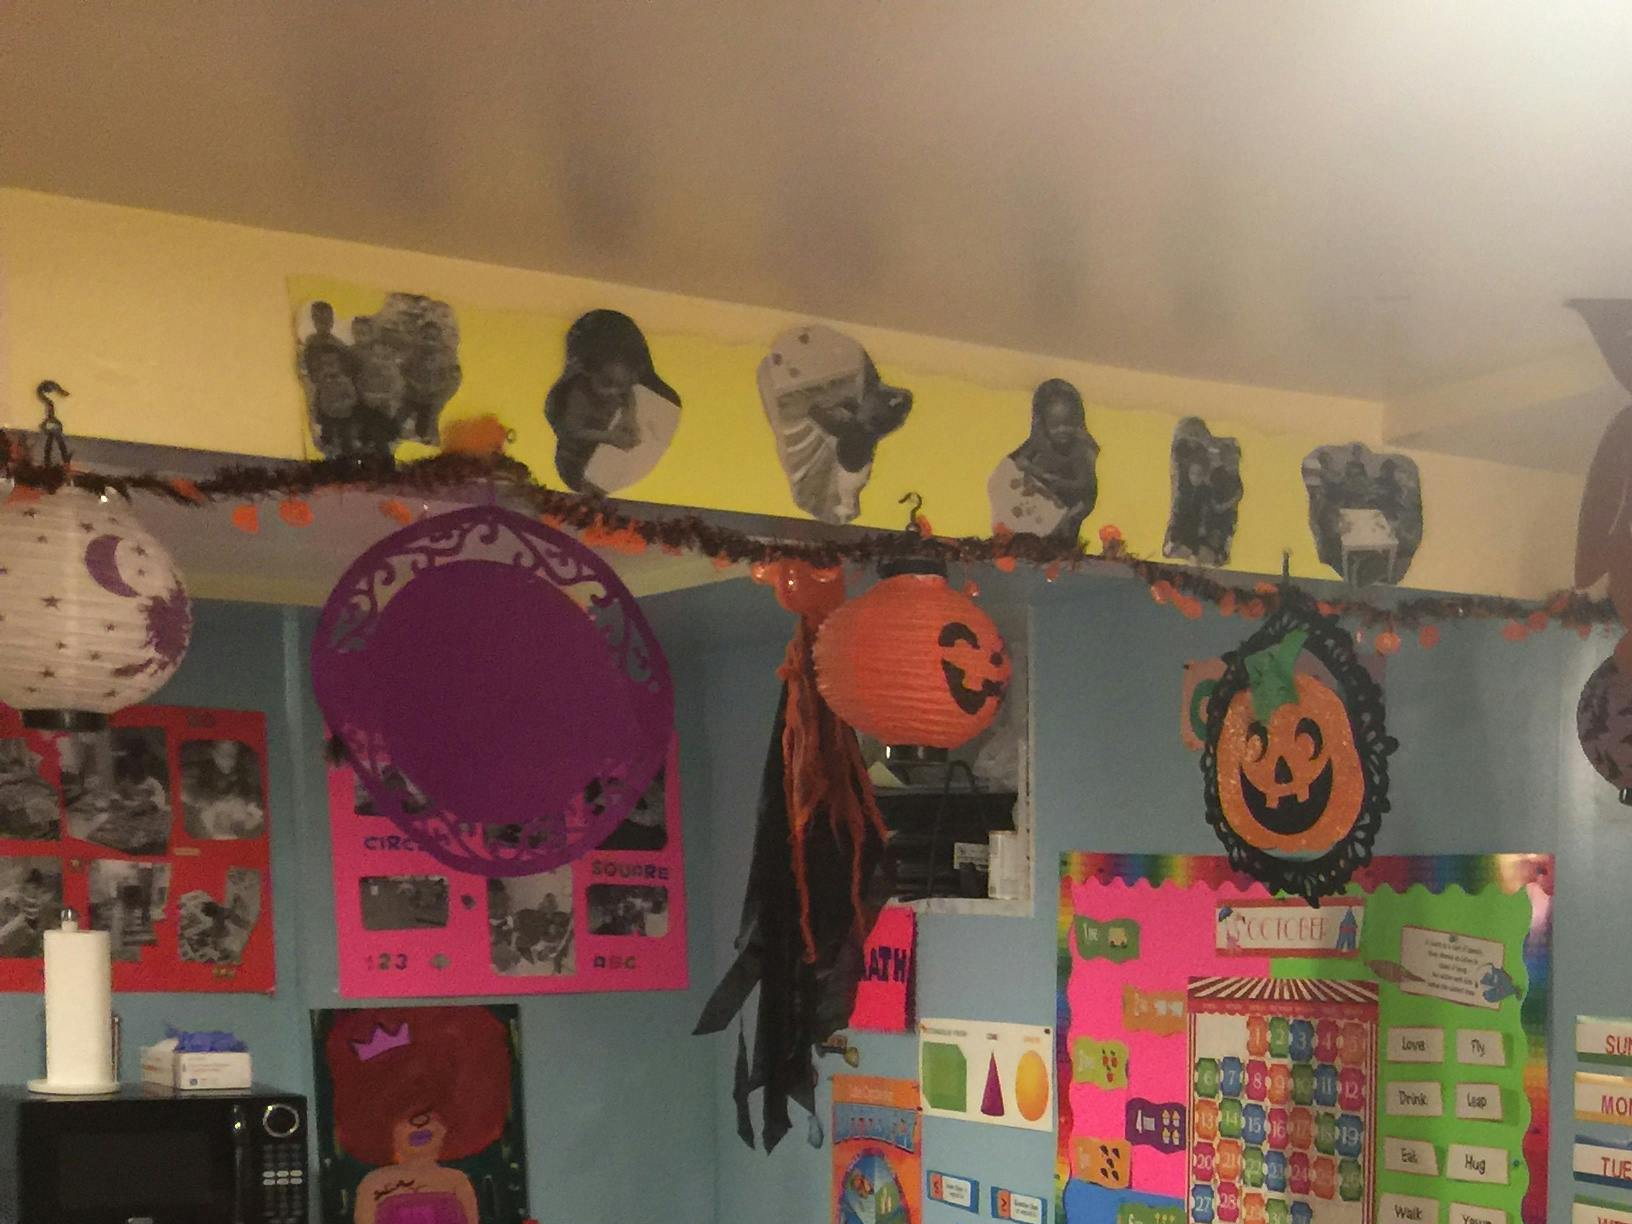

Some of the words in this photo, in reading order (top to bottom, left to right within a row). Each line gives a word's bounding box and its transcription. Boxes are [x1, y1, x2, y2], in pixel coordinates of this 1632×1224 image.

[1249, 1116, 1263, 1134] 15
[1464, 1154, 1486, 1175] Hug
[1195, 1196, 1212, 1212] 27
[1394, 1204, 1423, 1221] Walk
